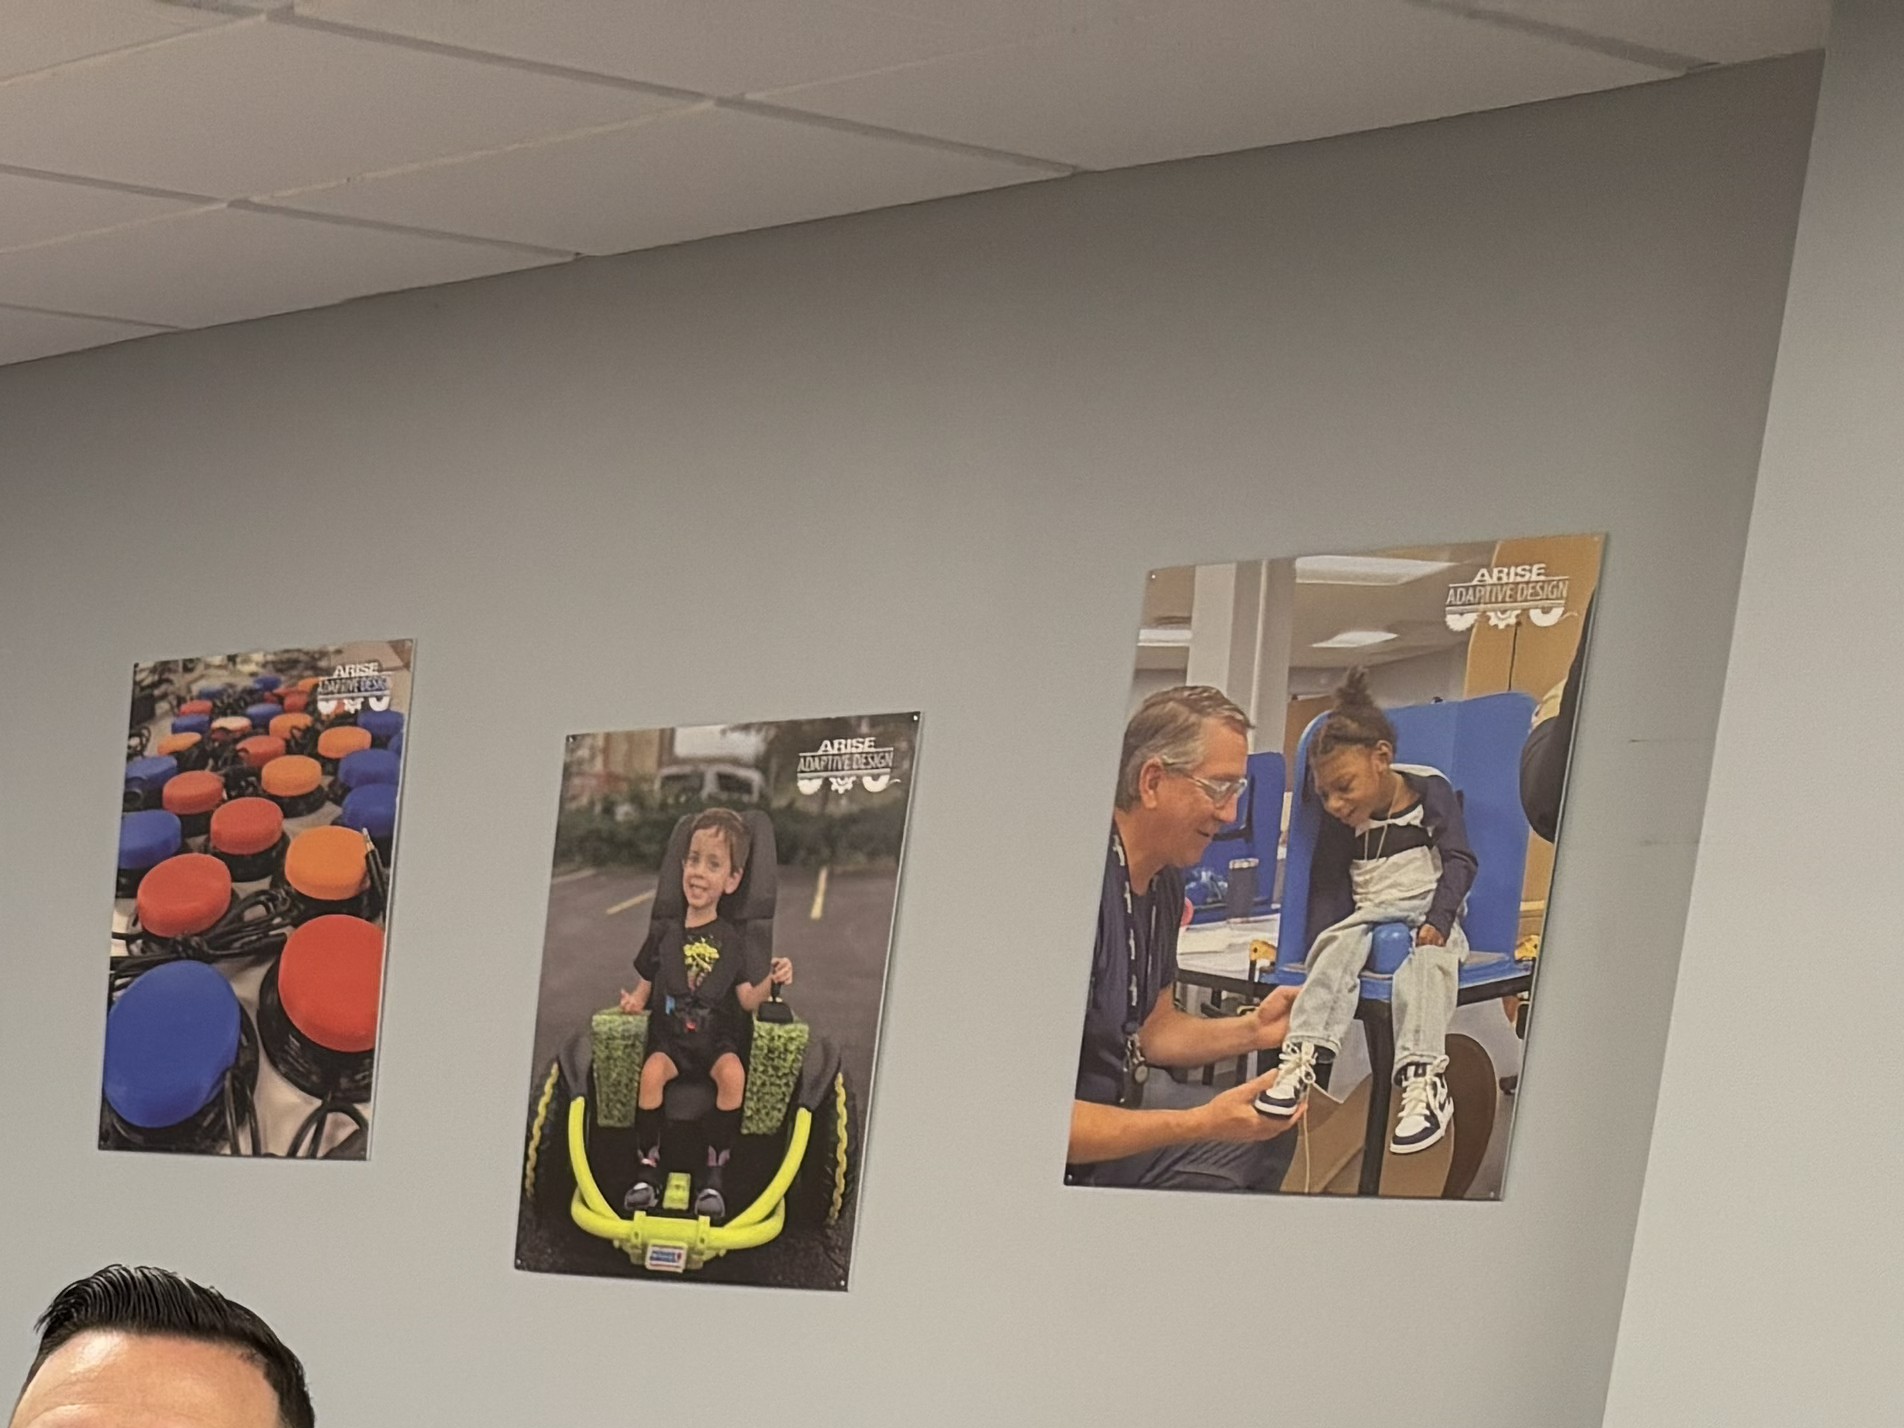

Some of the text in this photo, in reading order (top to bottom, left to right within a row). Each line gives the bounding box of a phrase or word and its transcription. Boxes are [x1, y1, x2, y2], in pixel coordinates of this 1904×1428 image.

[1472, 563, 1546, 583] ARISE
[1446, 580, 1569, 605] ADAPTIVE DESIGN
[333, 662, 379, 678] ARISE
[817, 737, 876, 753] ARISE
[797, 751, 893, 772] ADAPTIVE DESIGN
